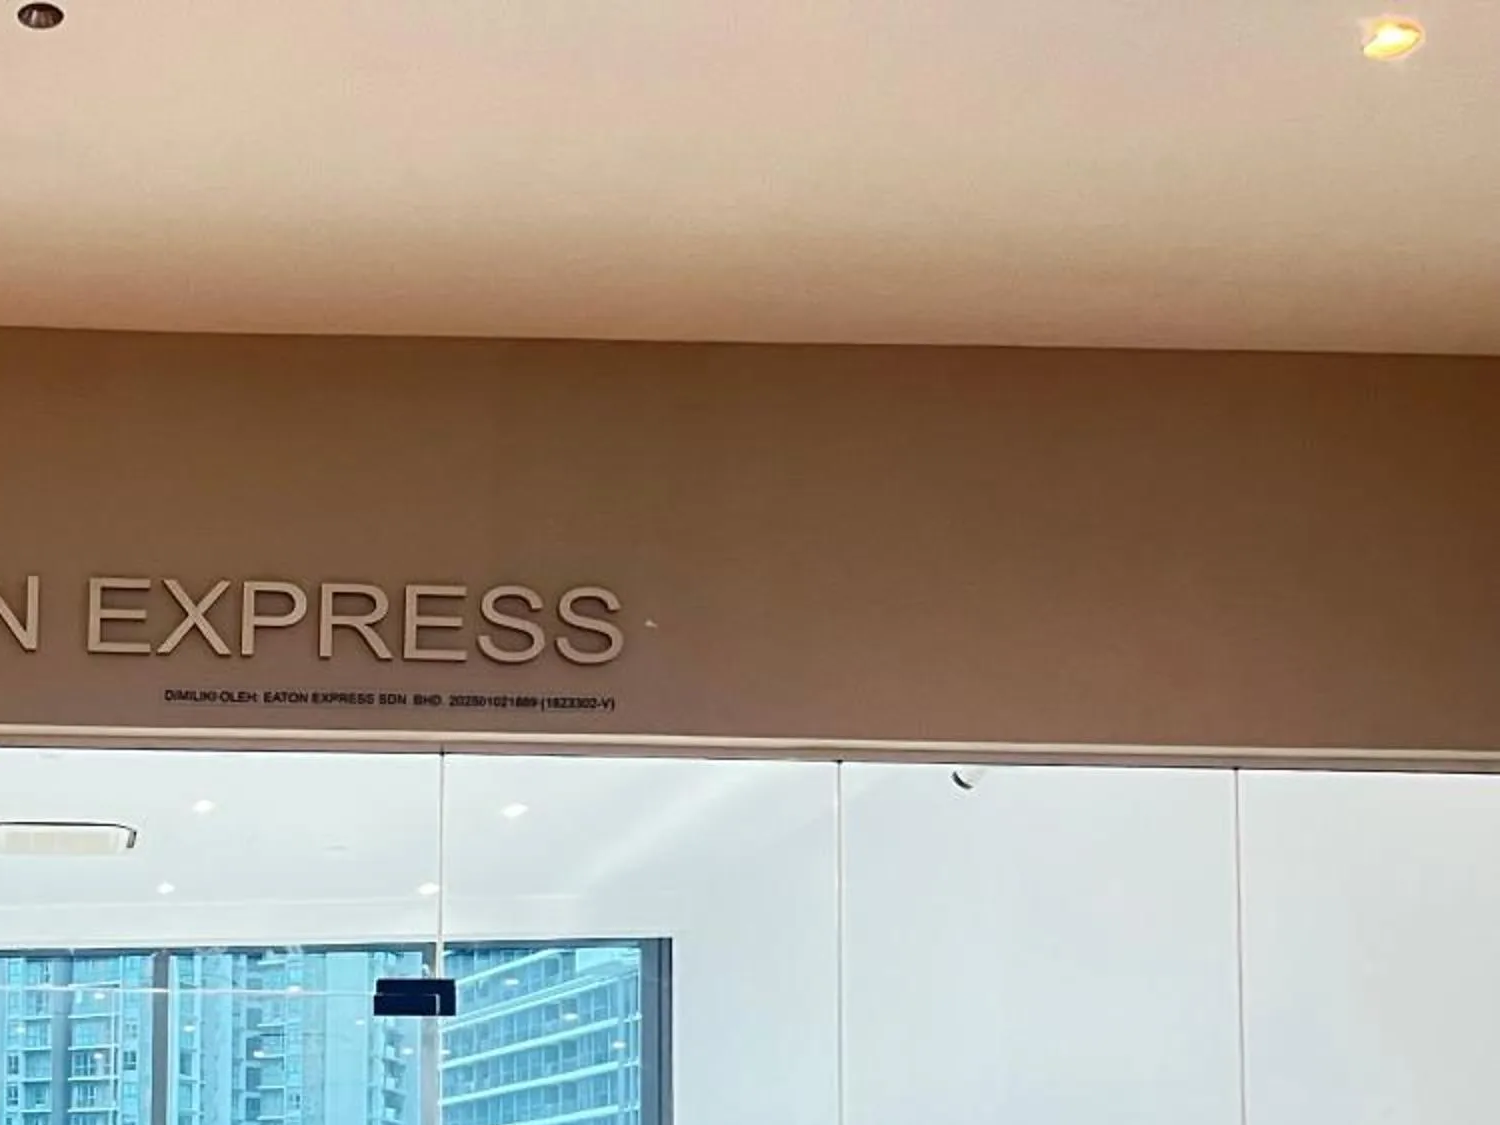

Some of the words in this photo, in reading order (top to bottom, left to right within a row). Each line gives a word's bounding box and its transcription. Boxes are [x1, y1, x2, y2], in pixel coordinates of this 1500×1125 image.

[86, 576, 625, 666] EXPRESS
[263, 691, 308, 704] EATON
[311, 692, 375, 706] EXPRESS
